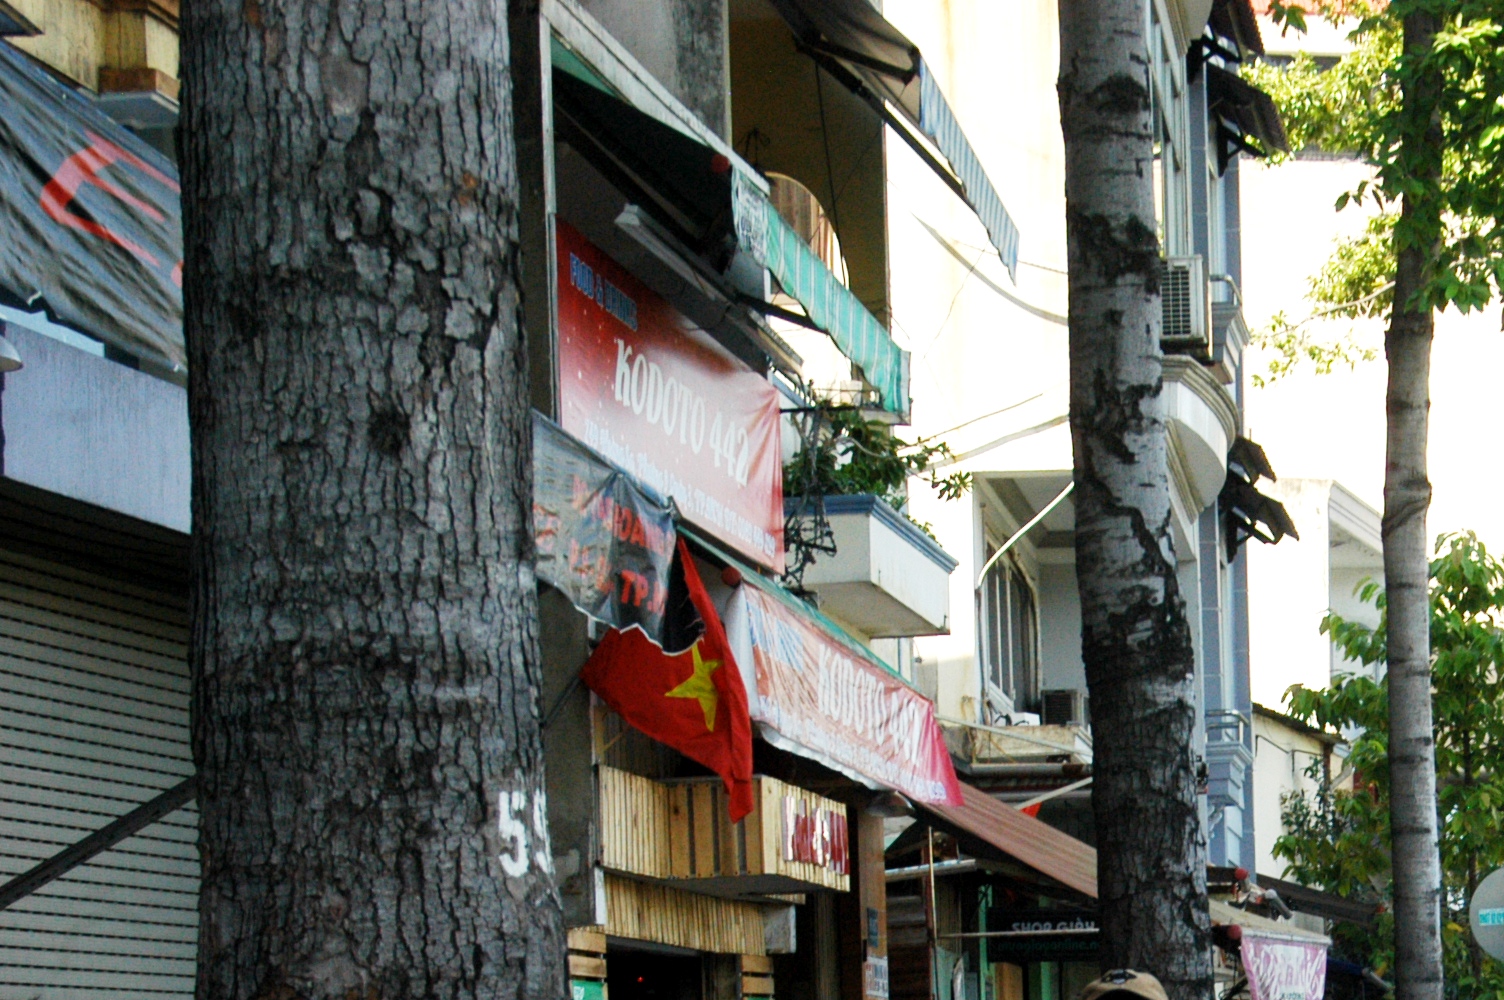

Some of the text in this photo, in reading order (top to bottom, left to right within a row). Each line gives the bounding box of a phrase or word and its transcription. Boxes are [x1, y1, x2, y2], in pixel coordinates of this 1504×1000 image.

[613, 338, 706, 455] KODOTO
[708, 411, 749, 487] 442
[817, 642, 887, 747] KODOTO
[1012, 920, 1053, 934] SHOP
